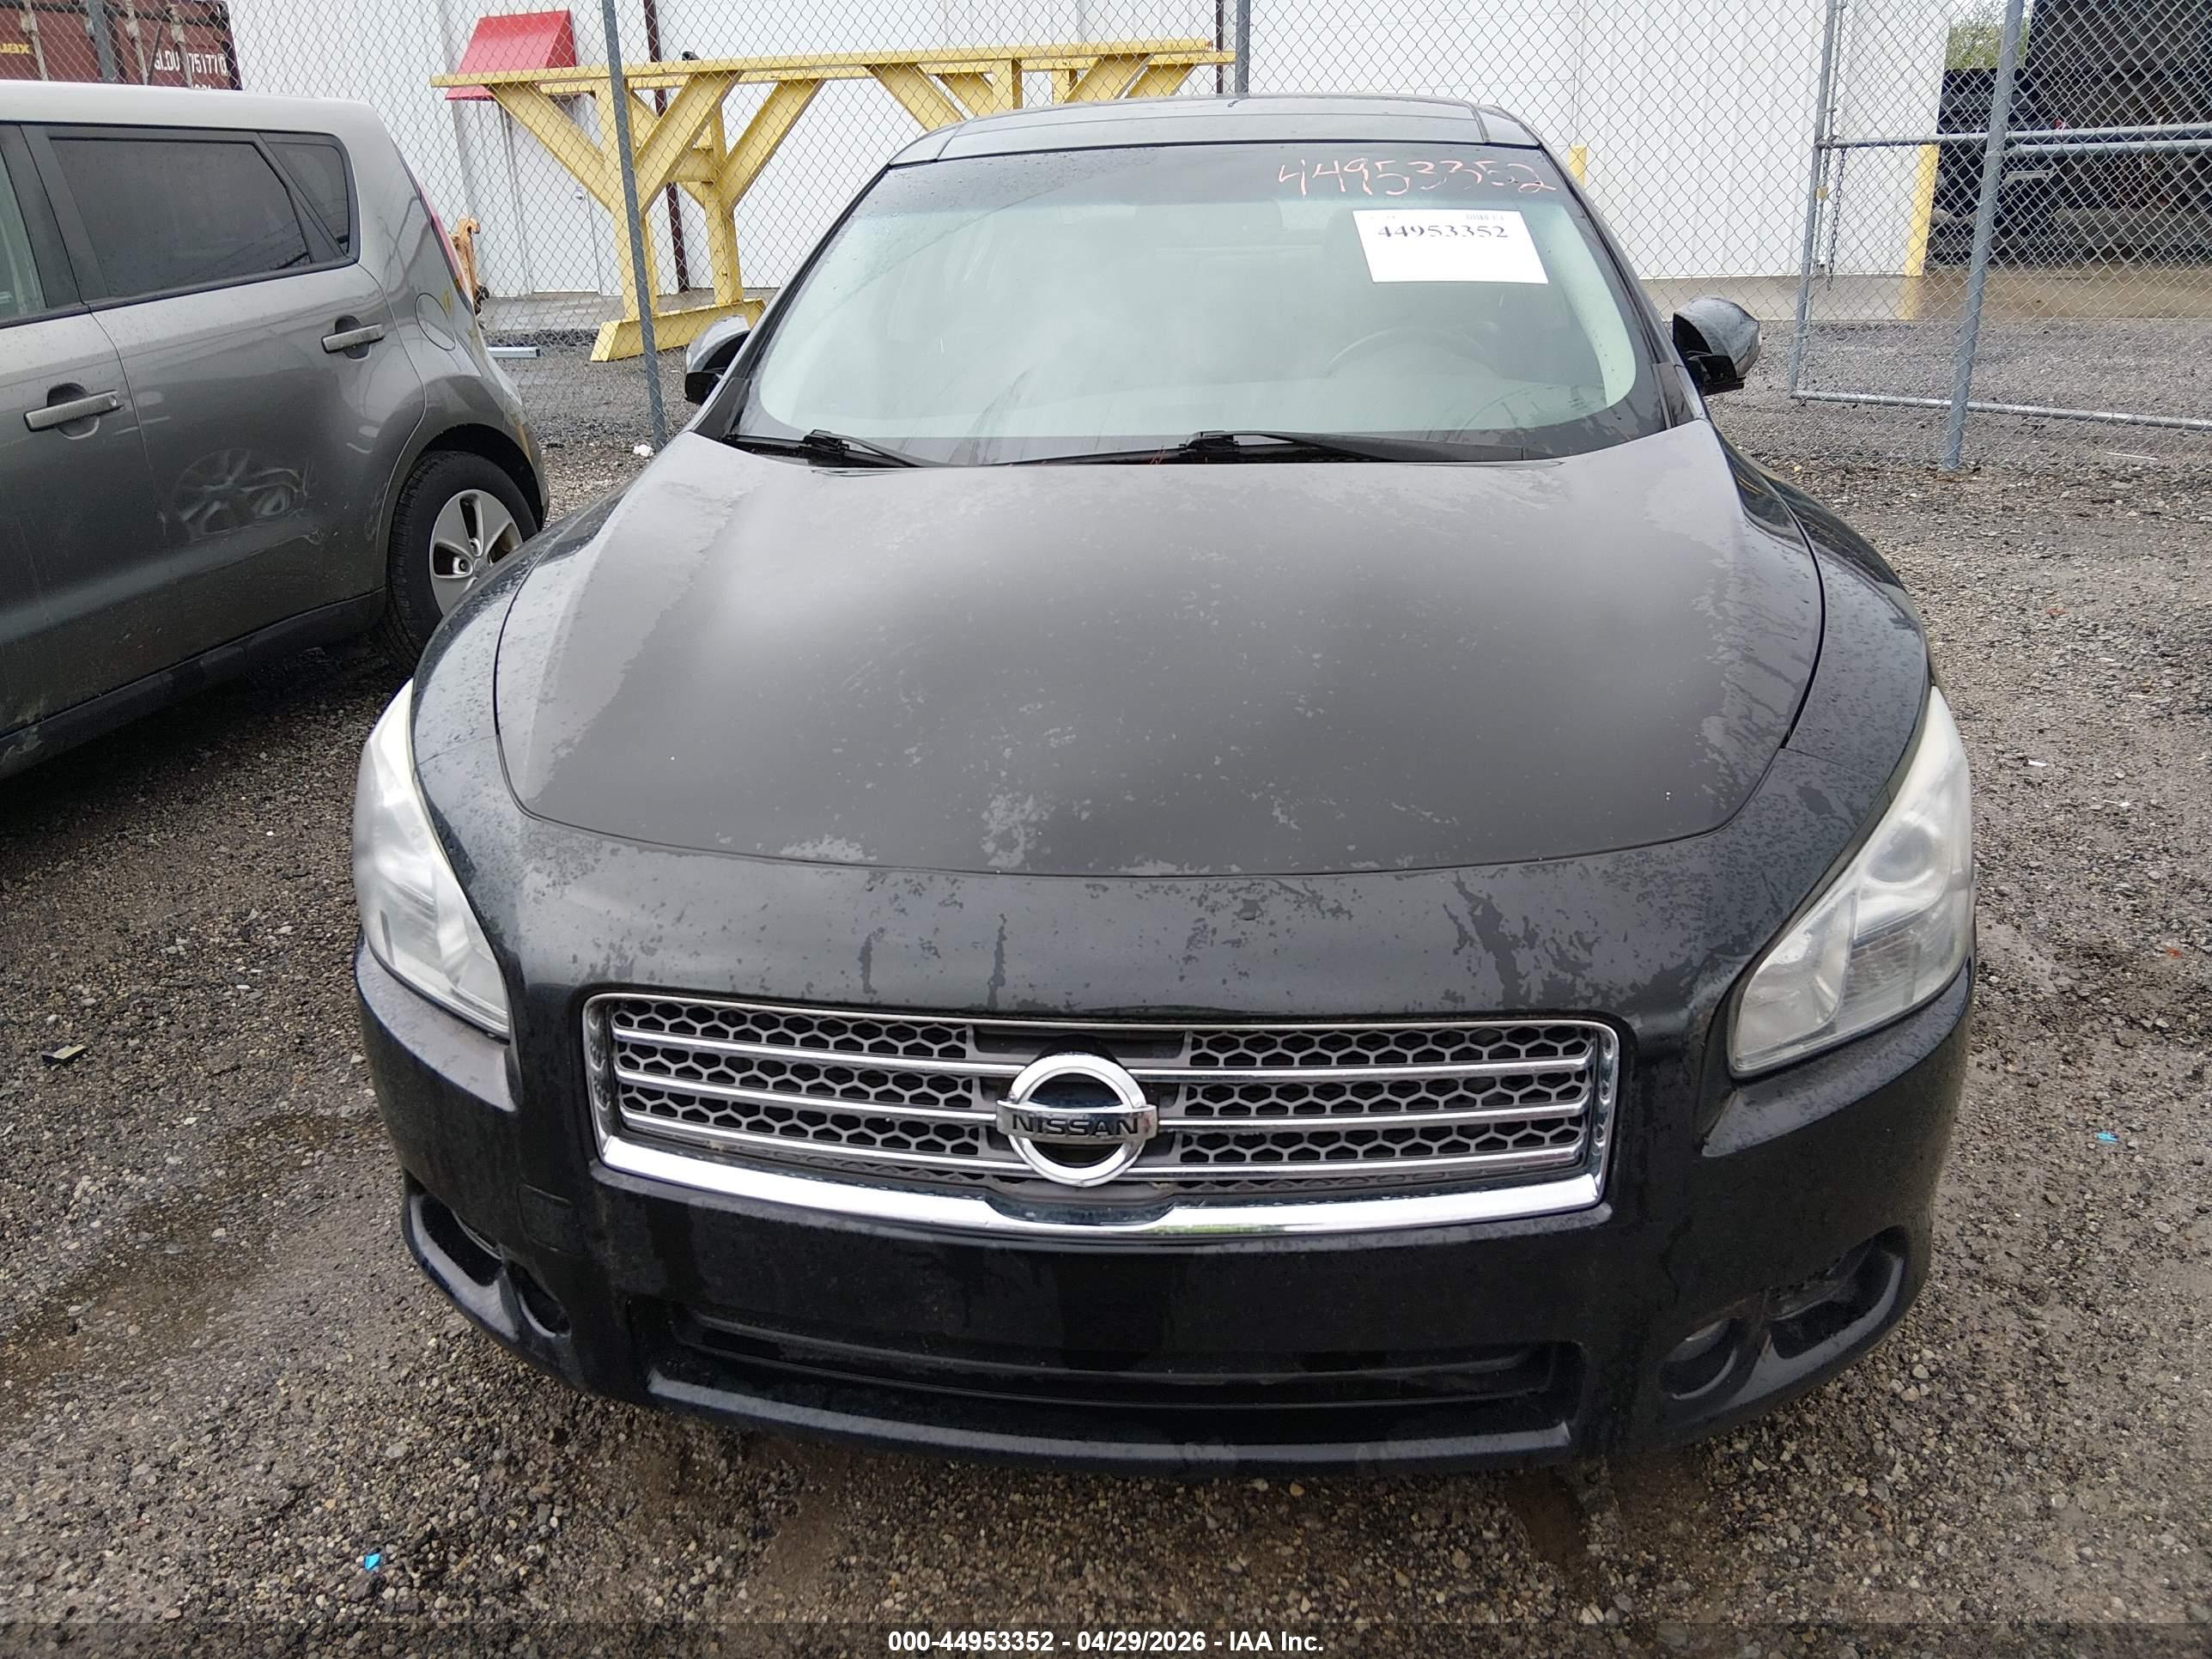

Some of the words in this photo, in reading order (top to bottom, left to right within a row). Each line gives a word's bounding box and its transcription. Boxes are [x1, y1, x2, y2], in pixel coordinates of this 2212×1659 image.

[1279, 158, 1556, 198] 44953352
[1377, 225, 1508, 237] 44953352
[1012, 1114, 1139, 1136] NISSAN
